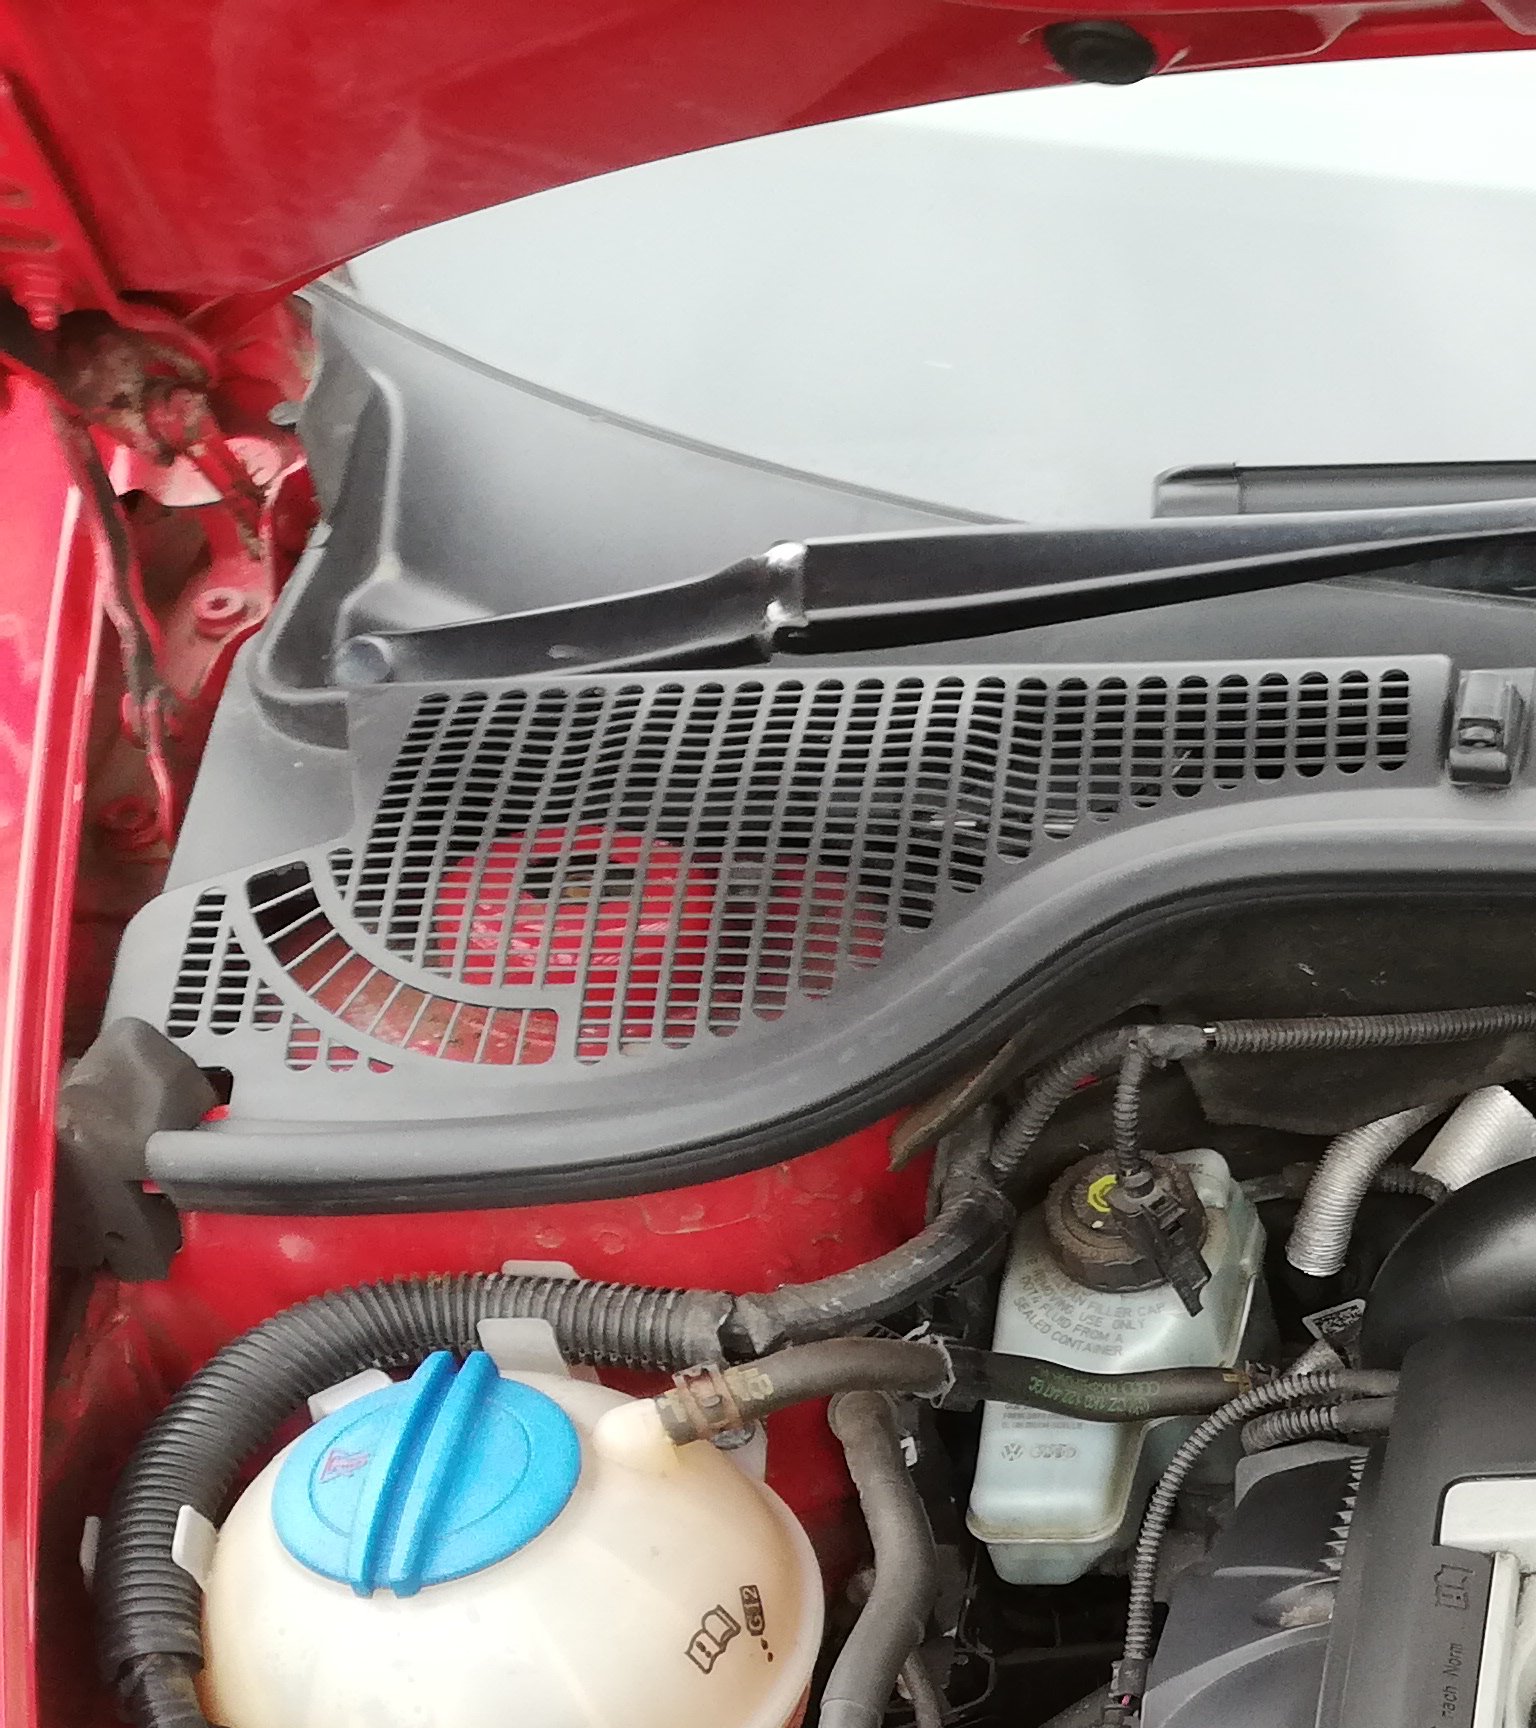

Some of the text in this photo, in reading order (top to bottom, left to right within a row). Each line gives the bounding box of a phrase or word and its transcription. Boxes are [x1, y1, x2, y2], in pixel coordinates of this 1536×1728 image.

[1013, 1296, 1124, 1357] SEALED CONTAINER
[1038, 1302, 1072, 1329] FLUID
[1072, 1323, 1110, 1342] FROM
[1115, 1333, 1124, 1344] A
[1079, 1312, 1104, 1328] USE
[1112, 1319, 1145, 1330] ONLY
[1088, 1301, 1132, 1318] FILLER
[1137, 1302, 1165, 1317] CAP
[1442, 1643, 1464, 1678] Norm
